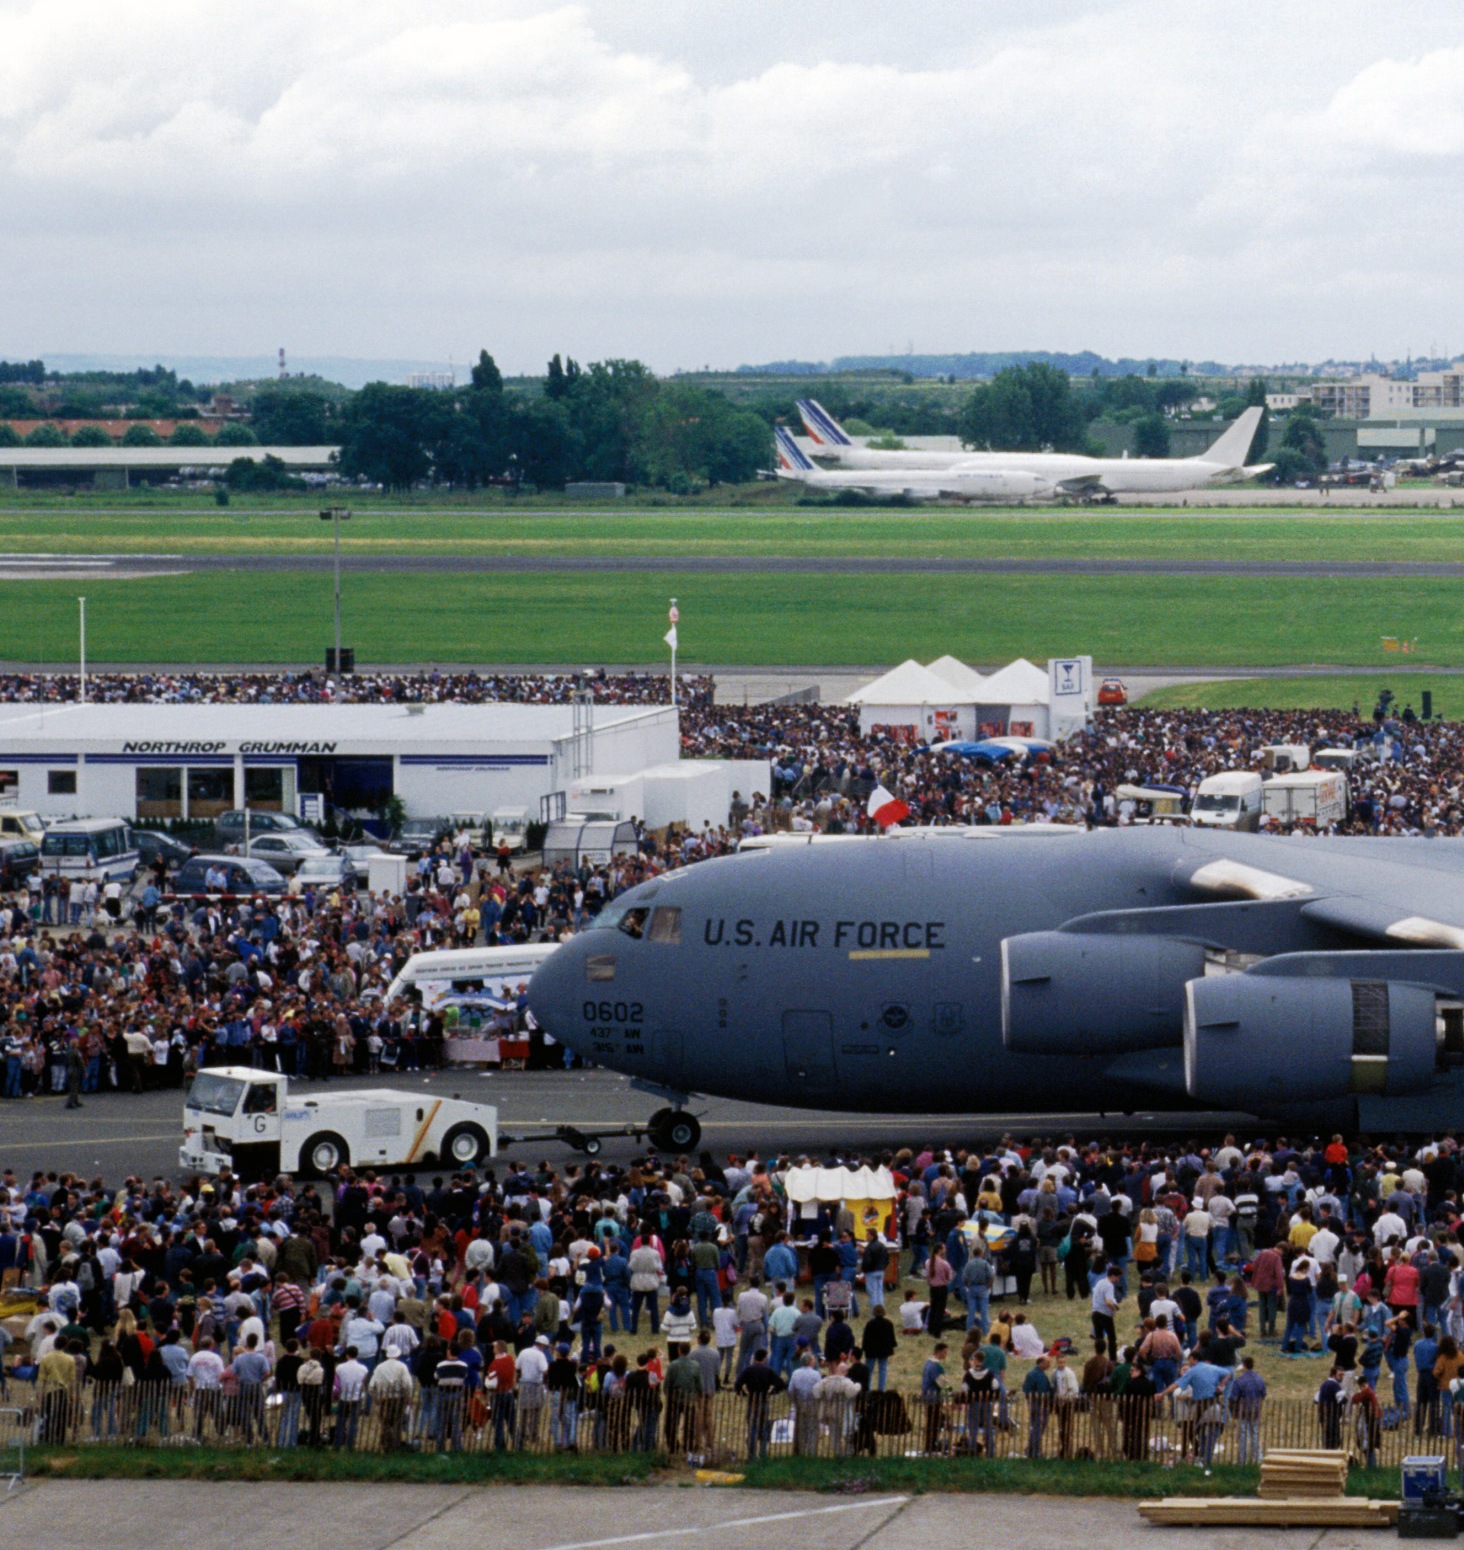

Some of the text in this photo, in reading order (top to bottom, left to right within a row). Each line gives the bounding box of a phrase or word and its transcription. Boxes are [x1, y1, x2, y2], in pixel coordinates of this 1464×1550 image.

[122, 741, 337, 753] NORTHROP GRUMMAN
[704, 918, 946, 949] U.S. AIR FORCE
[583, 1001, 644, 1023] 0602
[254, 1115, 266, 1133] G
